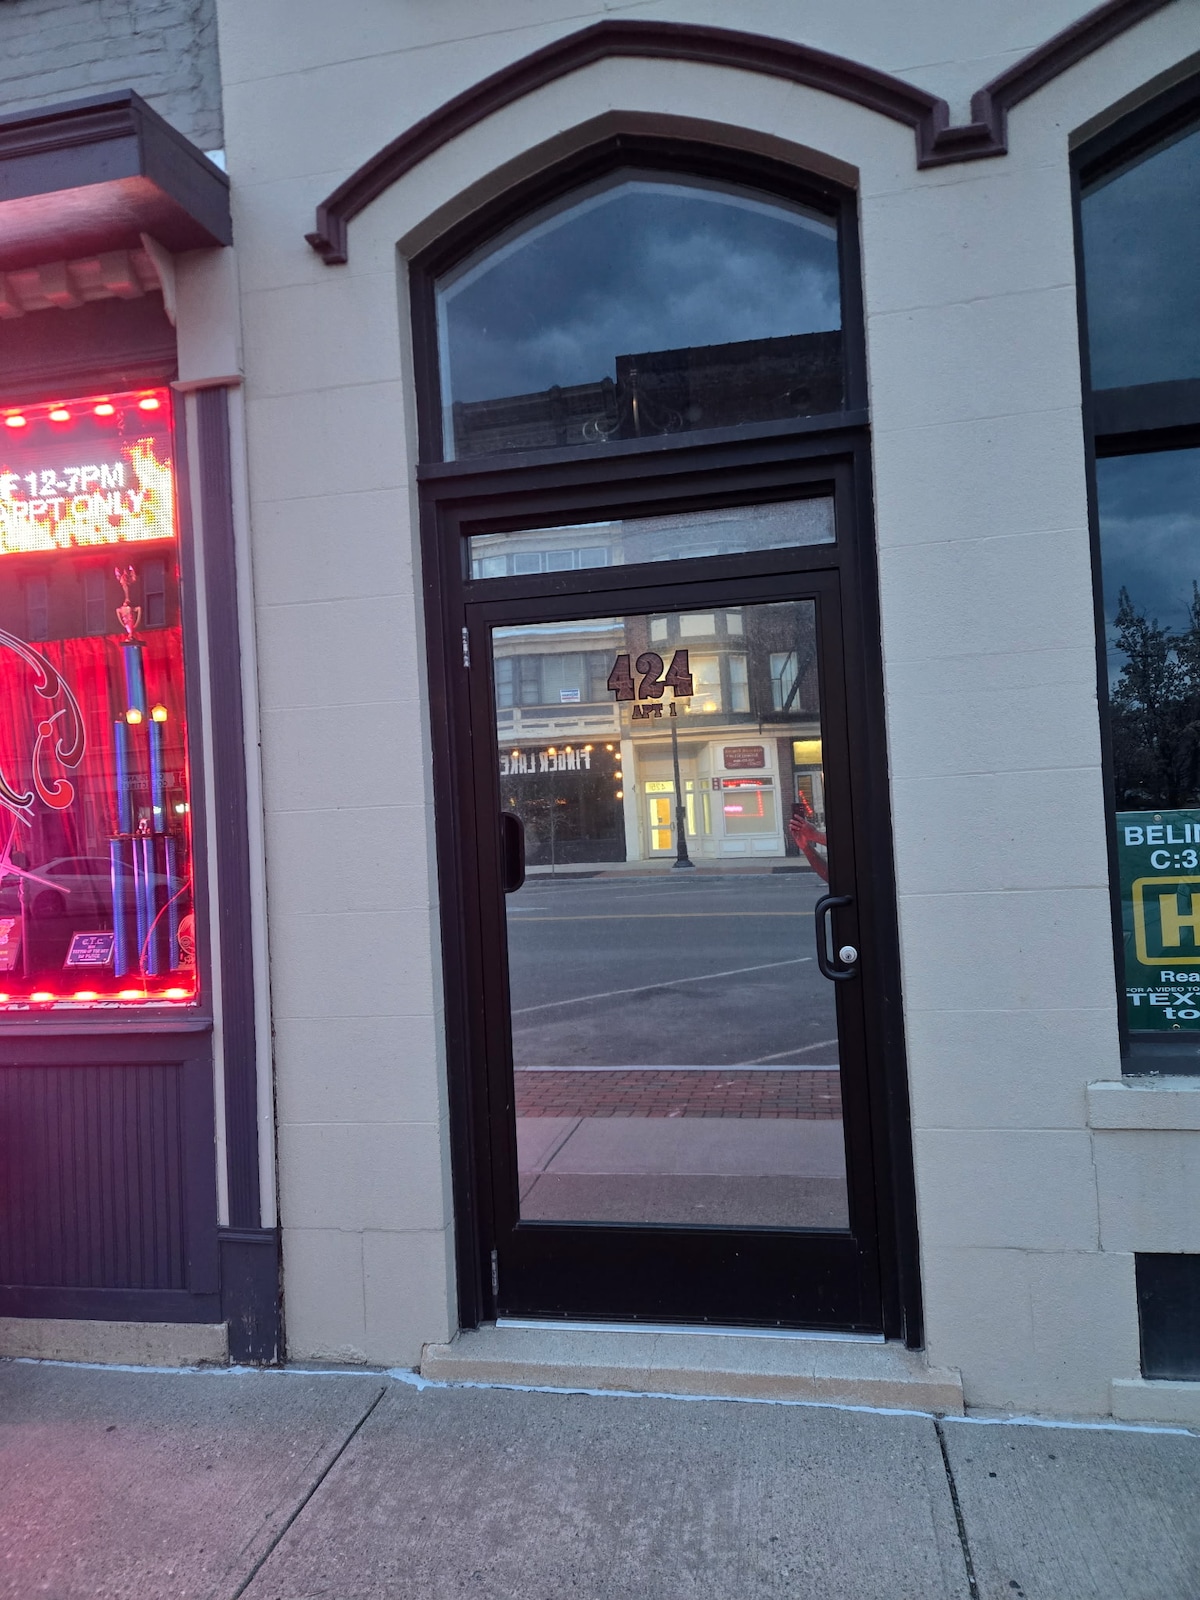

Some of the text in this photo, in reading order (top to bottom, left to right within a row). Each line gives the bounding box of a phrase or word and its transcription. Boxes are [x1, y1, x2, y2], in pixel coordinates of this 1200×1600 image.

[25, 461, 125, 497] 12-7PM
[71, 490, 146, 519] ONLY
[607, 649, 694, 701] 424
[632, 702, 678, 719] APT 1
[1160, 970, 1200, 983] Rea
[1126, 993, 1200, 1006] TEX
[1162, 1007, 1200, 1020] to
